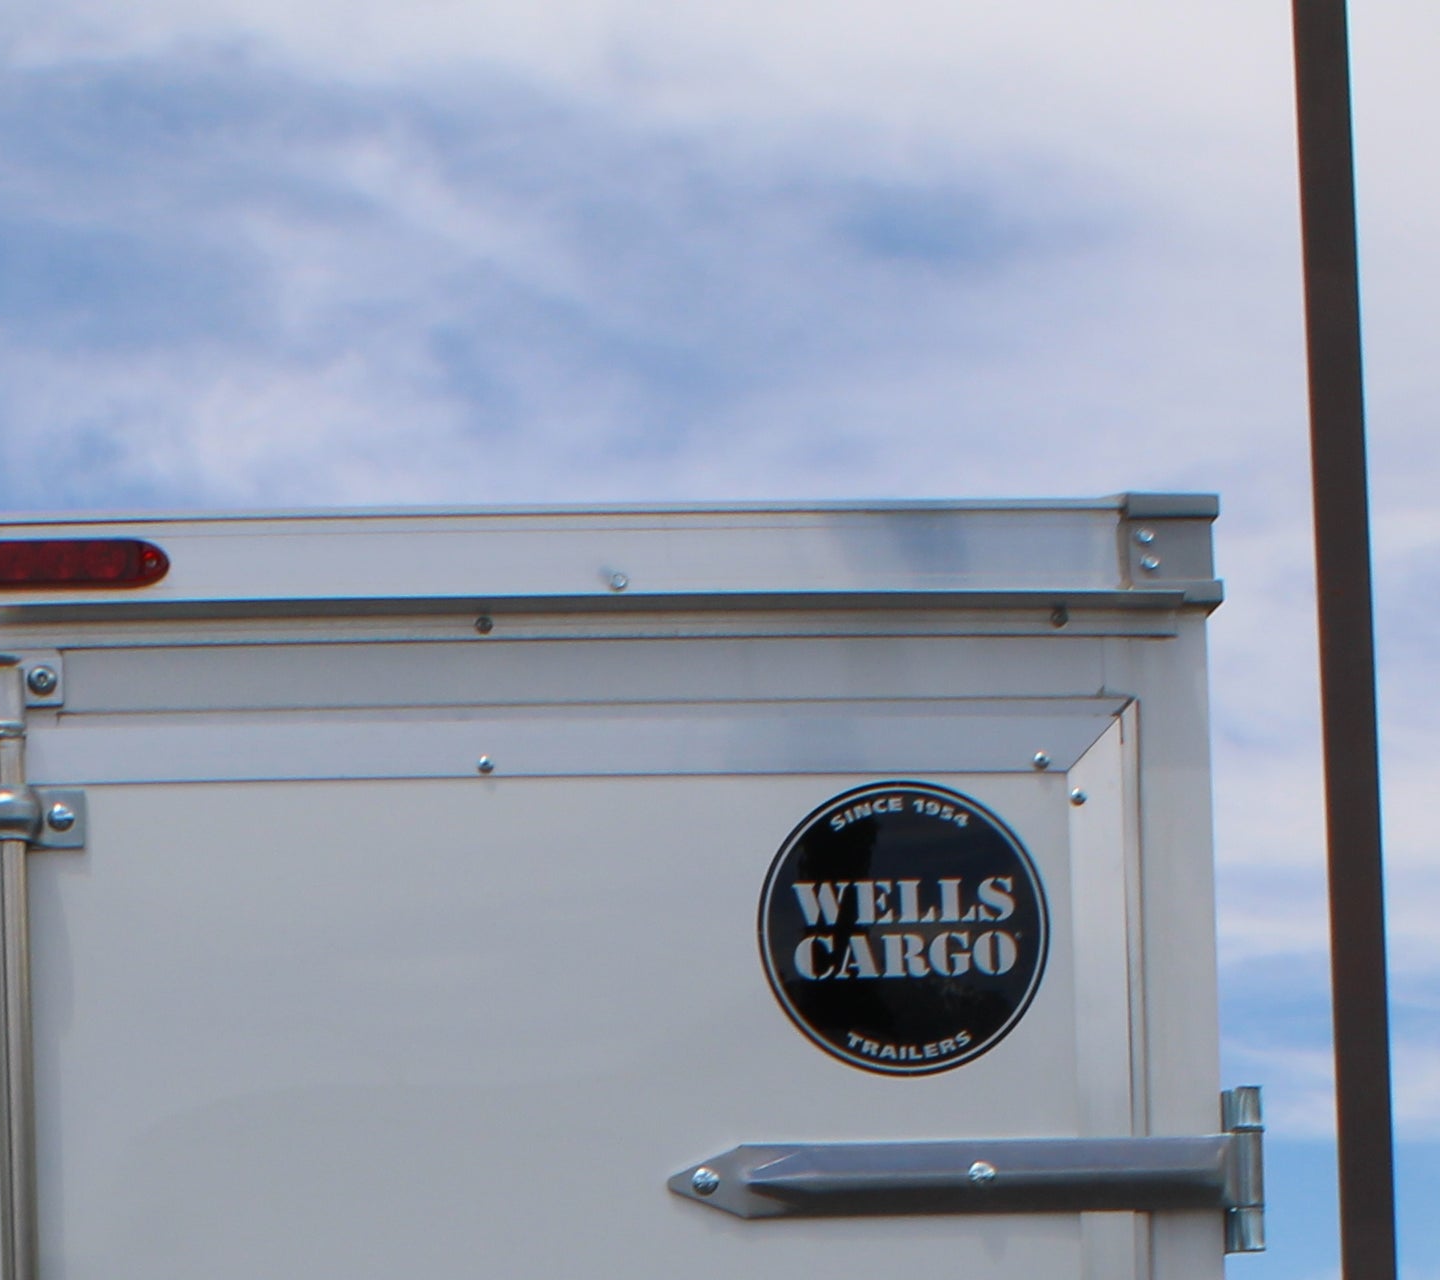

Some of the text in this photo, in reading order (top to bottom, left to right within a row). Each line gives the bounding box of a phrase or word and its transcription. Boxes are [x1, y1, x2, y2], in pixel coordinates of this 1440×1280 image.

[829, 797, 969, 832] SINCE 1954
[791, 876, 1016, 927] WELLS
[793, 930, 1018, 981] CARGO
[847, 1030, 972, 1061] TRAILERS
